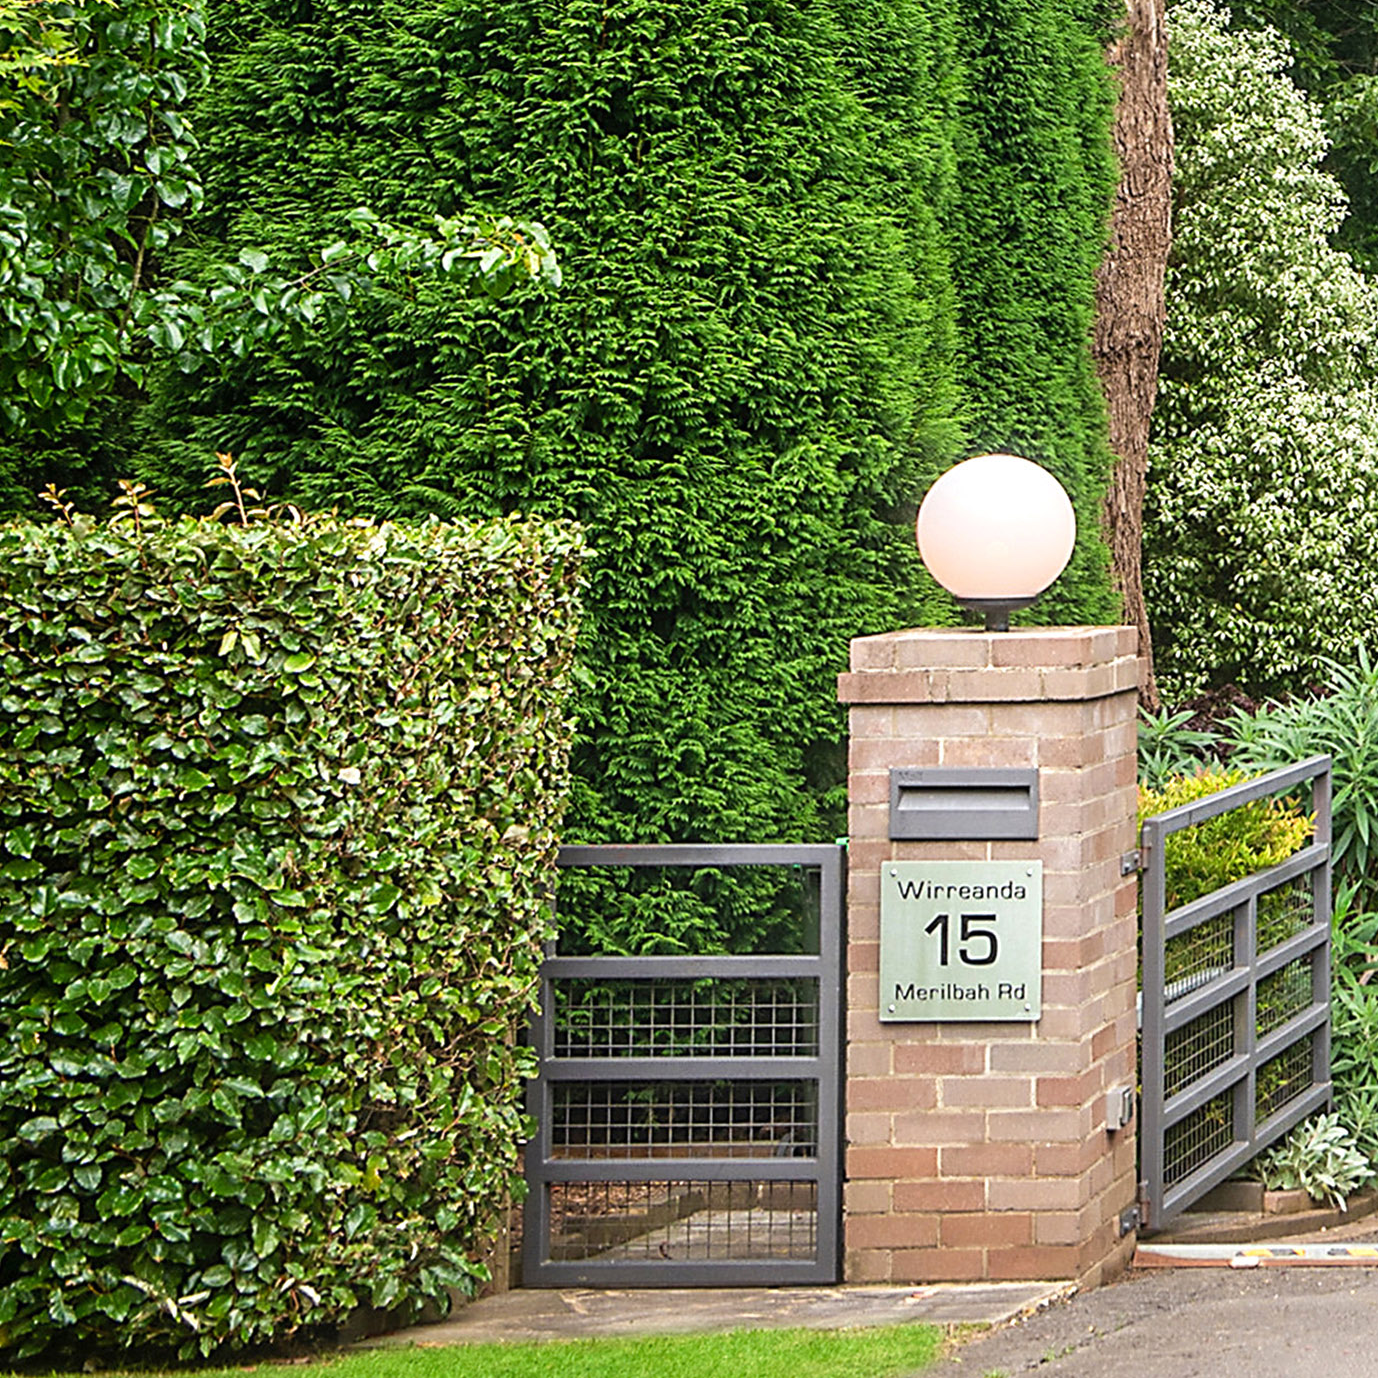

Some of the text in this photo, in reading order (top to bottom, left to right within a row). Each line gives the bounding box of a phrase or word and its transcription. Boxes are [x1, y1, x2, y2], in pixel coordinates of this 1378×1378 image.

[897, 881, 1026, 899] Wirreanda
[924, 914, 998, 966] 15
[895, 983, 1026, 1000] Merilbah Rd
